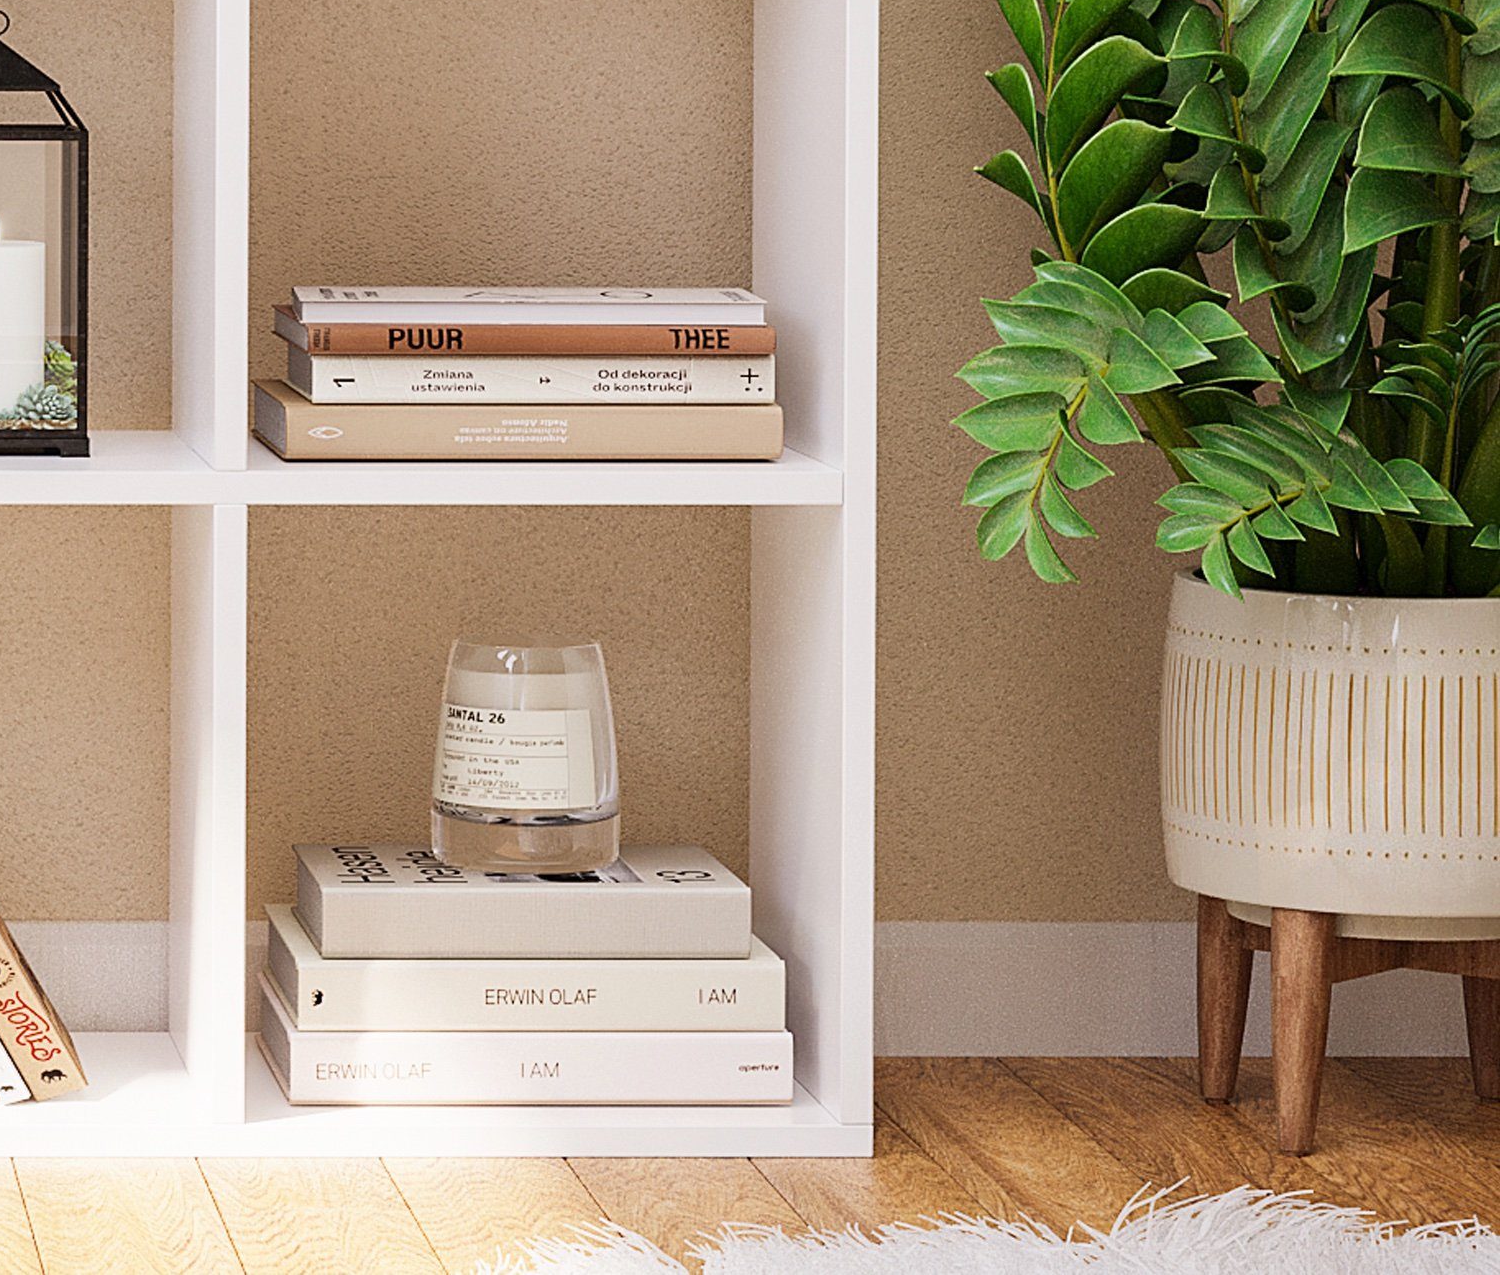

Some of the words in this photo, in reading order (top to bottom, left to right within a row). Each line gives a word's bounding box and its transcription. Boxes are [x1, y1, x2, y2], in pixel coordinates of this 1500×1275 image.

[388, 328, 464, 351] PUUR
[668, 328, 730, 350] THEE
[422, 369, 474, 380] Zmiana
[597, 369, 619, 380] Od
[622, 369, 688, 382] dekoracji
[411, 382, 486, 392] ustawienia
[592, 381, 611, 393] do
[614, 381, 693, 394] konstrukcji
[446, 707, 484, 723] SANTAL
[488, 712, 506, 724] 26
[331, 845, 396, 885] Hasen
[484, 988, 545, 1005] ERWIN
[548, 988, 598, 1005] OLAF
[706, 988, 738, 1005] AM
[315, 1062, 378, 1080] ERWIN
[382, 1062, 433, 1080] OLAF
[528, 1062, 561, 1079] AM
[737, 1062, 781, 1074] aperture
